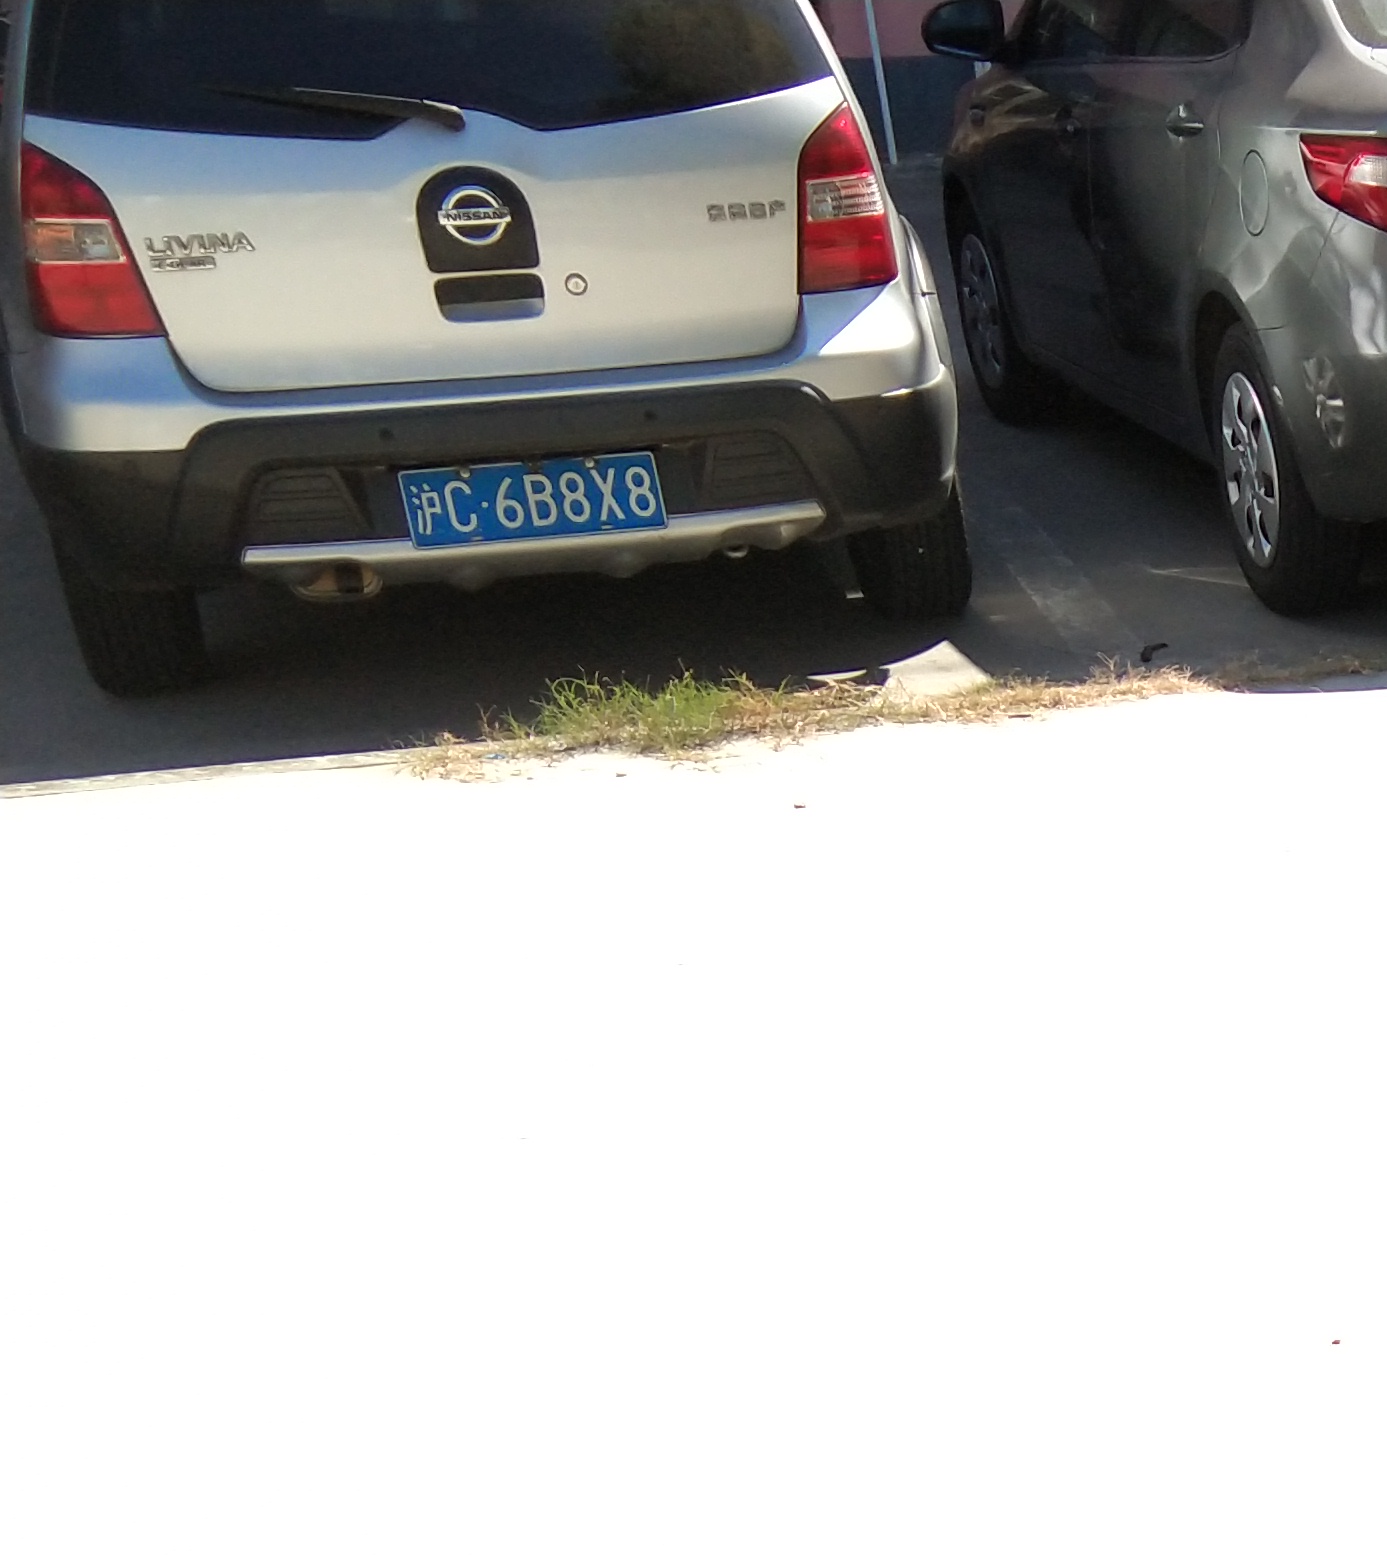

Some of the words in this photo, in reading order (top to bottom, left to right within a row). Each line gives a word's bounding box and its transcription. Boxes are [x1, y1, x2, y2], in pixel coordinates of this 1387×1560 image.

[446, 210, 505, 222] NISSAN
[143, 231, 256, 256] LIVINA
[409, 466, 656, 535] 沪C·6B8X8
